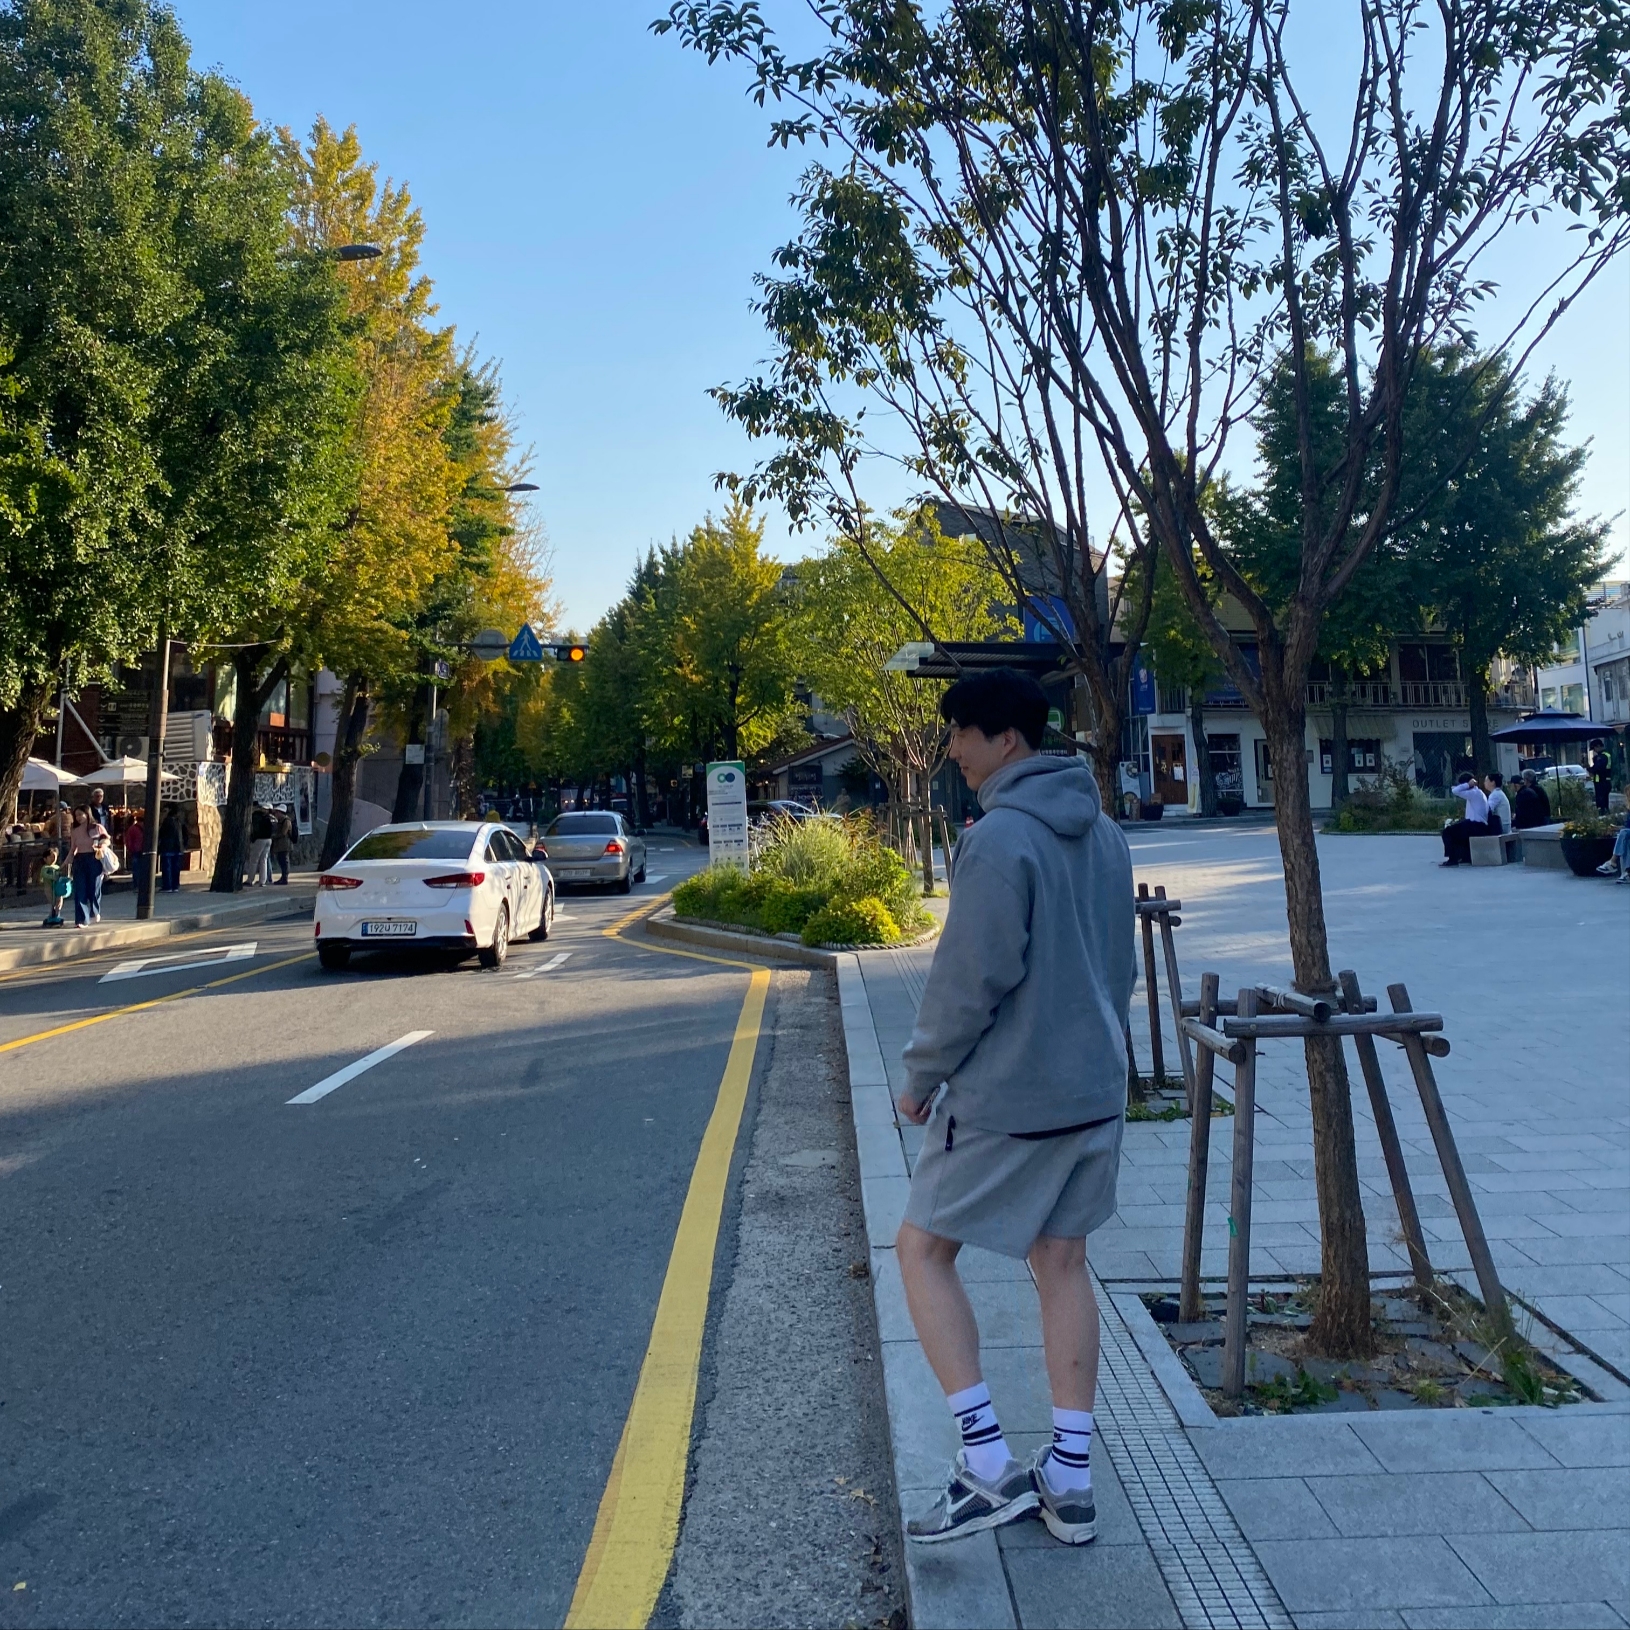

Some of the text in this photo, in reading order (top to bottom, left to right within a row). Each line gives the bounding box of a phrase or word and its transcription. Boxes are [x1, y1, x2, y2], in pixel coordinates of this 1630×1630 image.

[1413, 719, 1499, 728] OUTLET SRE
[393, 923, 413, 933] 7174
